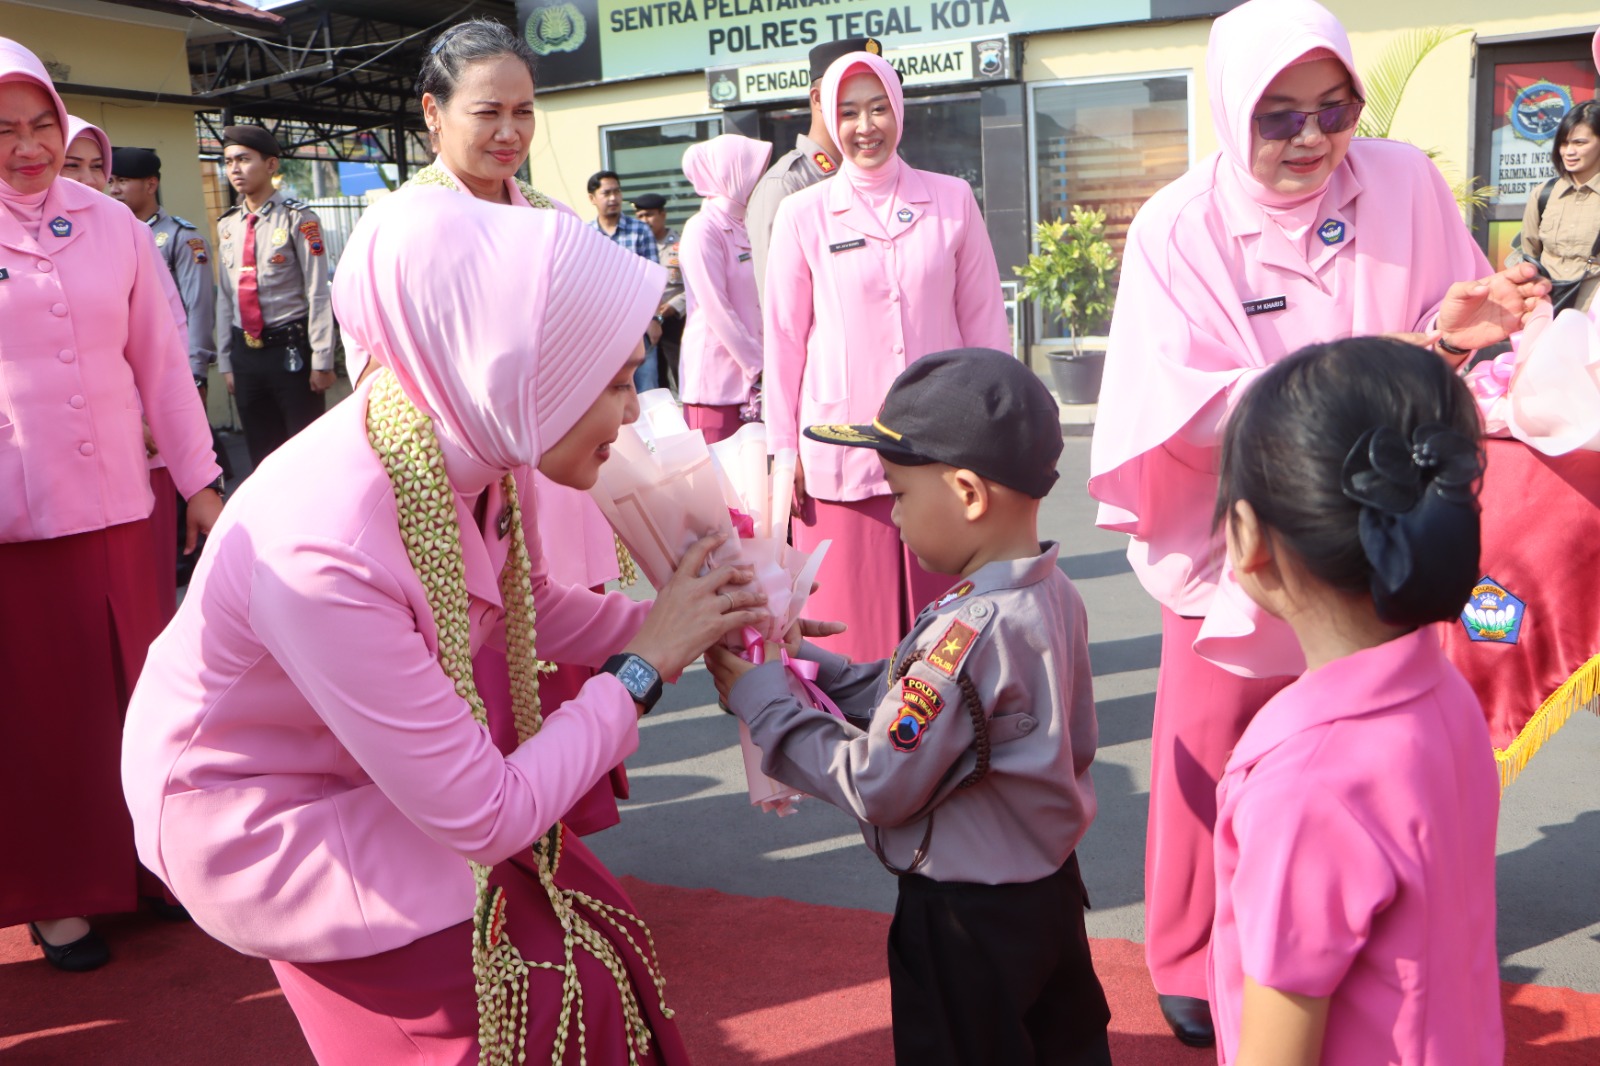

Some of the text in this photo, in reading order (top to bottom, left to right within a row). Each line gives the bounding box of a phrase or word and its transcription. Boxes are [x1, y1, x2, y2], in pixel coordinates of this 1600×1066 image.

[610, 0, 841, 33] SENTRA PELAY
[709, 0, 1010, 55] POLRES TEGAL KOTA
[745, 51, 964, 93] PENGAD YARAKAT
[1499, 151, 1553, 165] PUSAT INFO
[1498, 166, 1556, 179] KRIMINAL NAS
[1498, 182, 1526, 194] POLRES
[1263, 300, 1284, 310] KHARIS
[930, 653, 953, 671] POLISI
[904, 693, 918, 702] JAWA
[909, 679, 937, 703] POLDA
